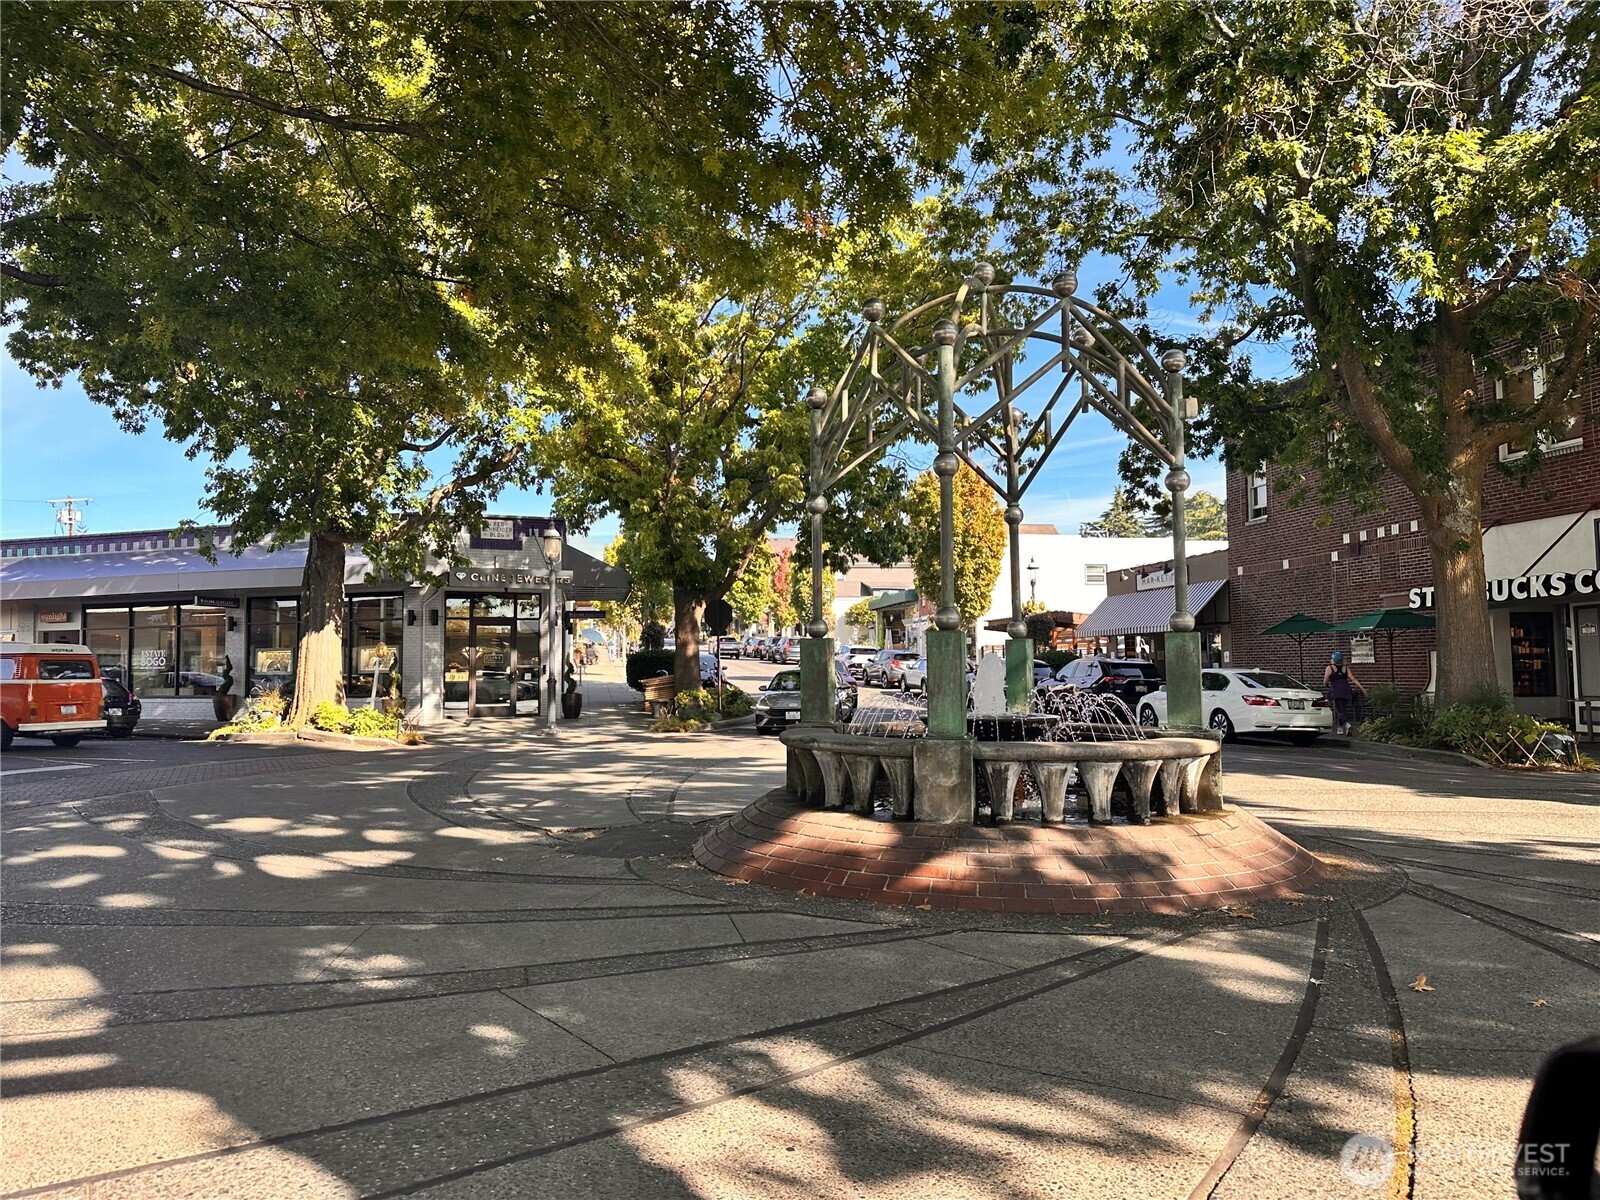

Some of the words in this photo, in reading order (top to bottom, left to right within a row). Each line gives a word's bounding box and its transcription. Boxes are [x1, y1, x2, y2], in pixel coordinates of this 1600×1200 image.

[471, 573, 506, 582] CLINE
[509, 574, 571, 585] JEWELRS
[1408, 572, 1566, 609] STUCKS
[1574, 569, 1600, 594] C
[40, 612, 67, 622] sunlight
[141, 649, 166, 657] ESTATE
[140, 657, 166, 667] BOGO
